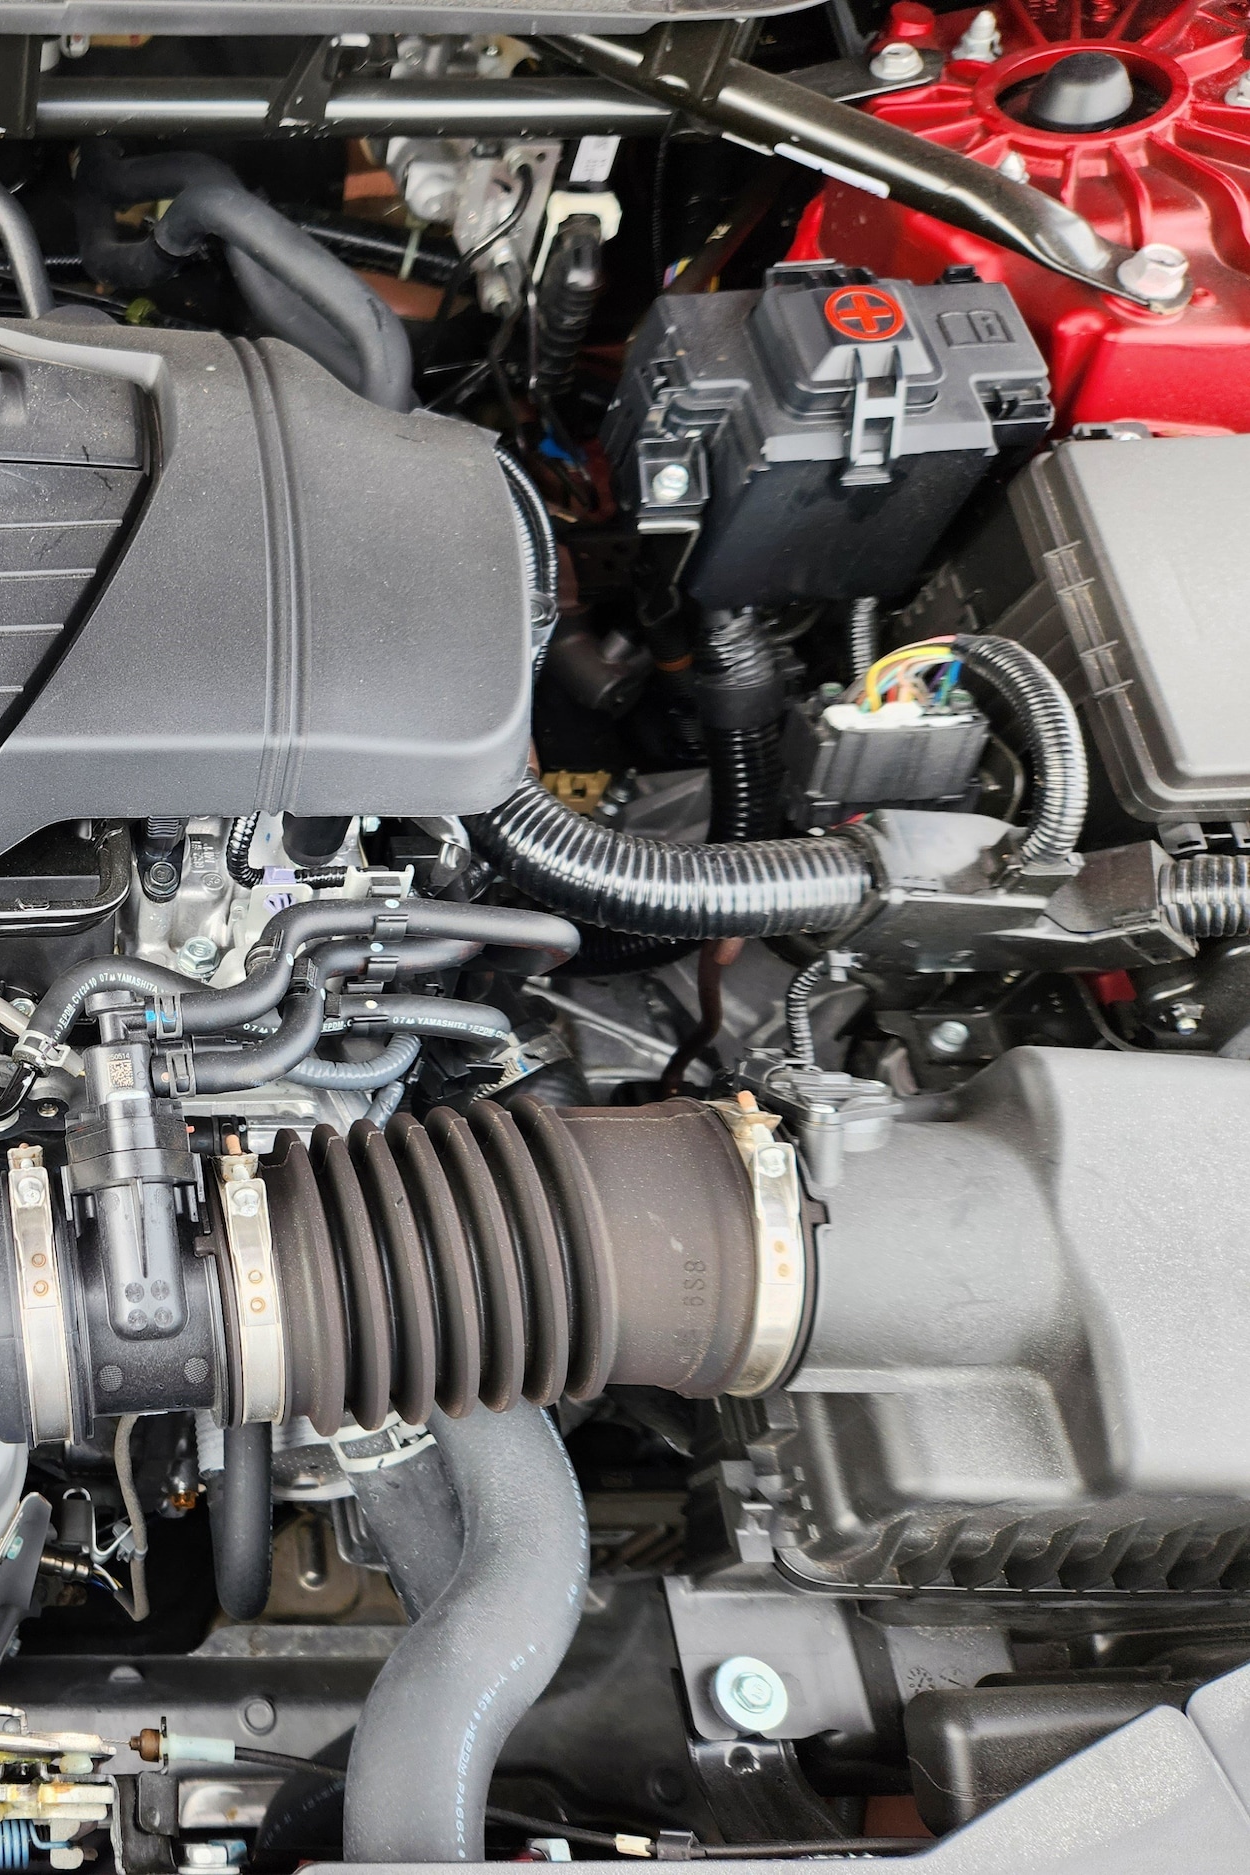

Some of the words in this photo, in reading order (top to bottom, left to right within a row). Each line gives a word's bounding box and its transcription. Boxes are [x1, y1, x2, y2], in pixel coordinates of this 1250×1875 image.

[100, 973, 108, 982] 07
[117, 973, 158, 993] YAMASHITA
[243, 1023, 258, 1032] 07
[417, 1017, 467, 1030] YAMASHITA
[478, 1673, 508, 1711] Y-TEC
